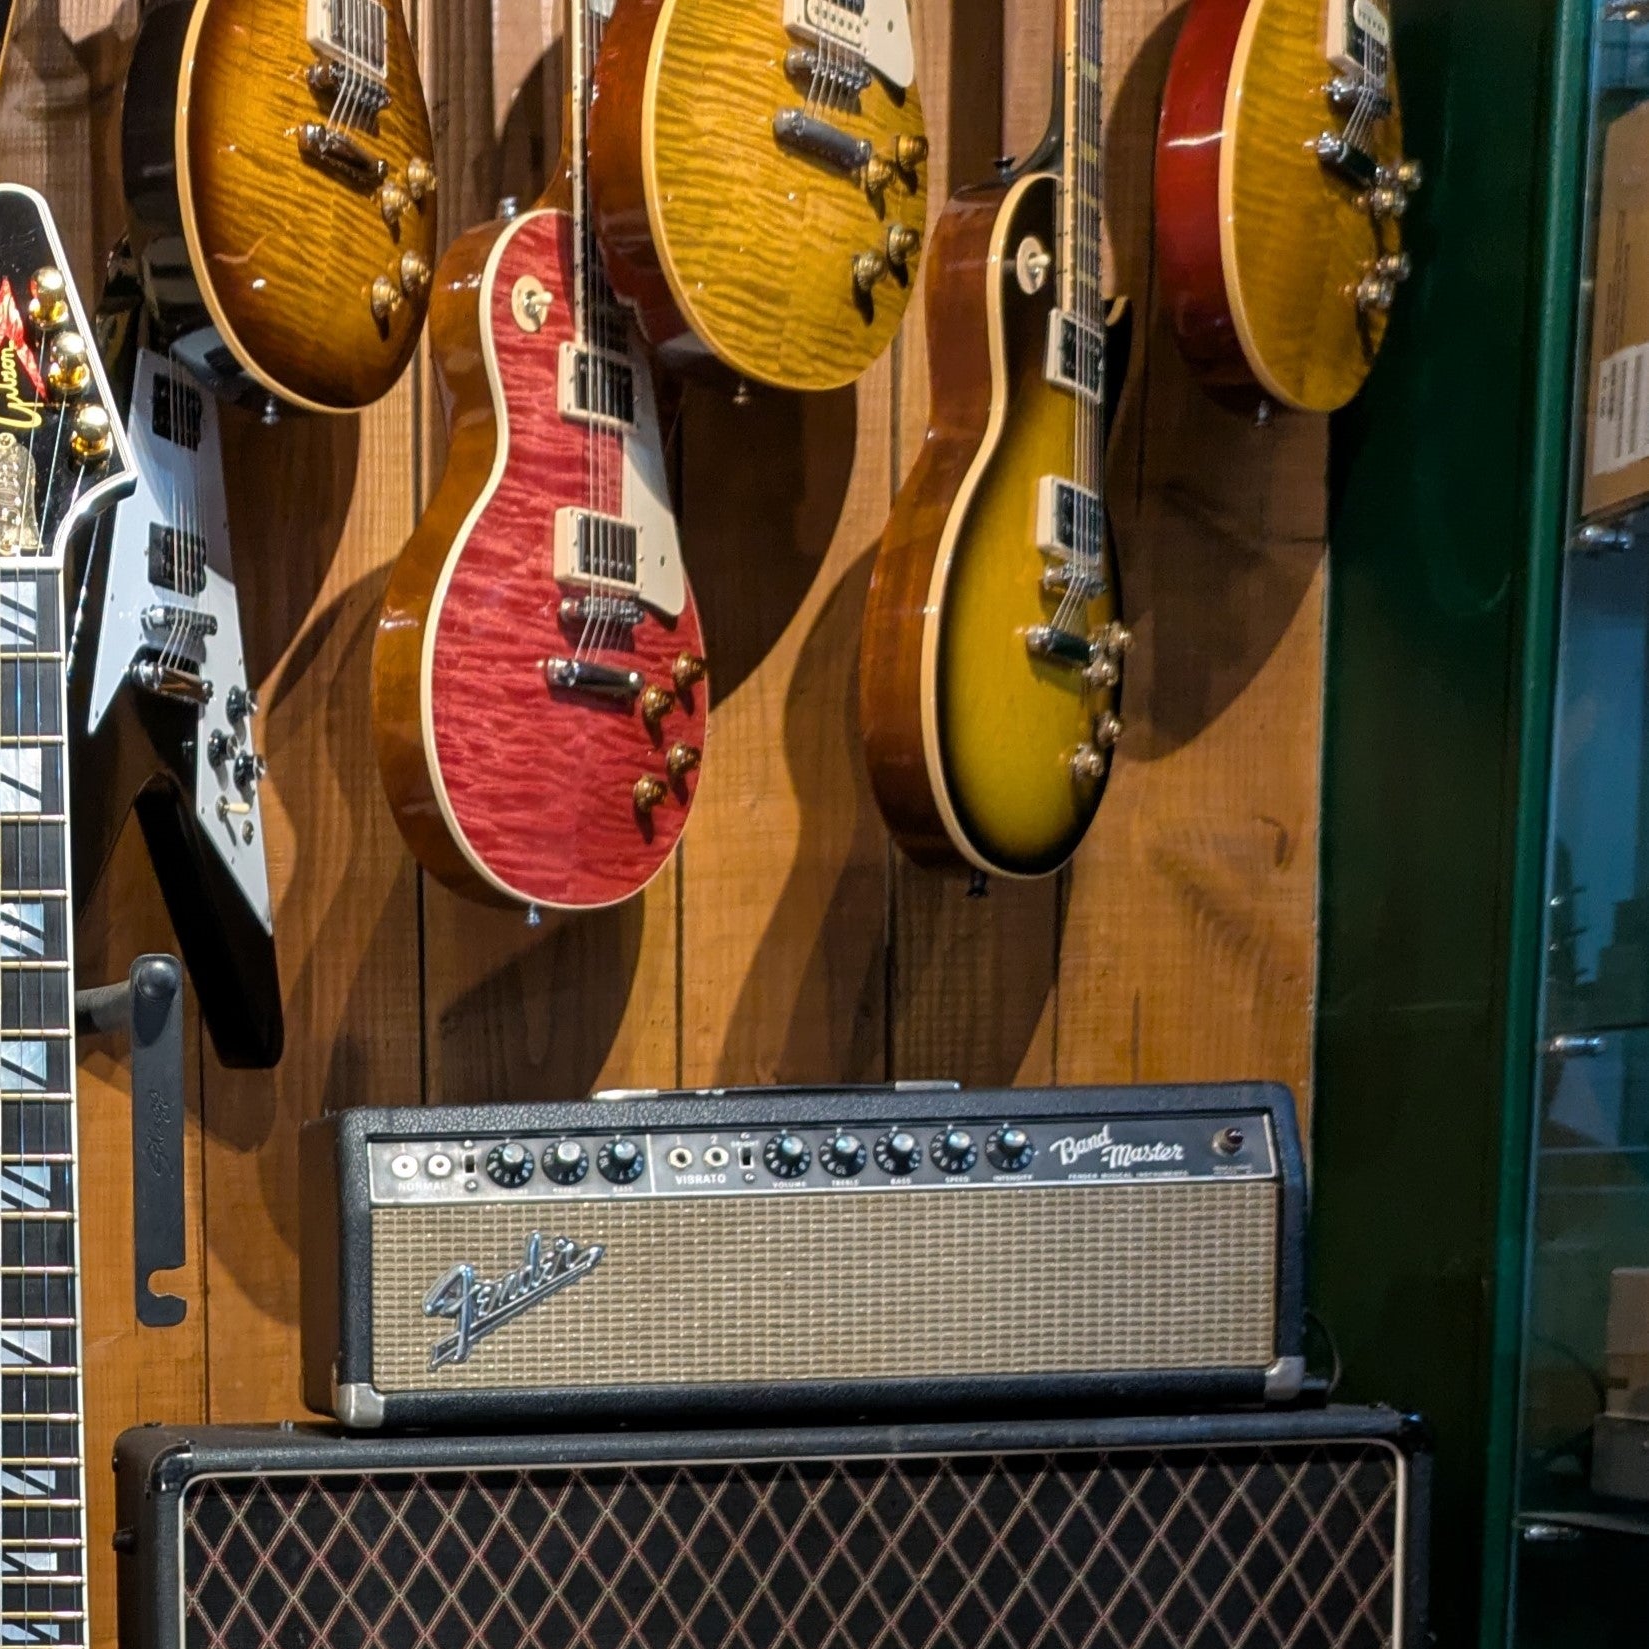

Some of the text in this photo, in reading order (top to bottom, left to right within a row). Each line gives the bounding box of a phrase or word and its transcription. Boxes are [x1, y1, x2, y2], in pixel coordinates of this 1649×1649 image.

[1050, 1124, 1184, 1169] Band Master
[675, 1174, 727, 1185] VIBRATO
[890, 1177, 912, 1185] BASS
[993, 1174, 1033, 1182] INTENSITY
[398, 1182, 448, 1192] NORMAL
[772, 1181, 807, 1189] VOLUME
[422, 1230, 606, 1370] Fender
